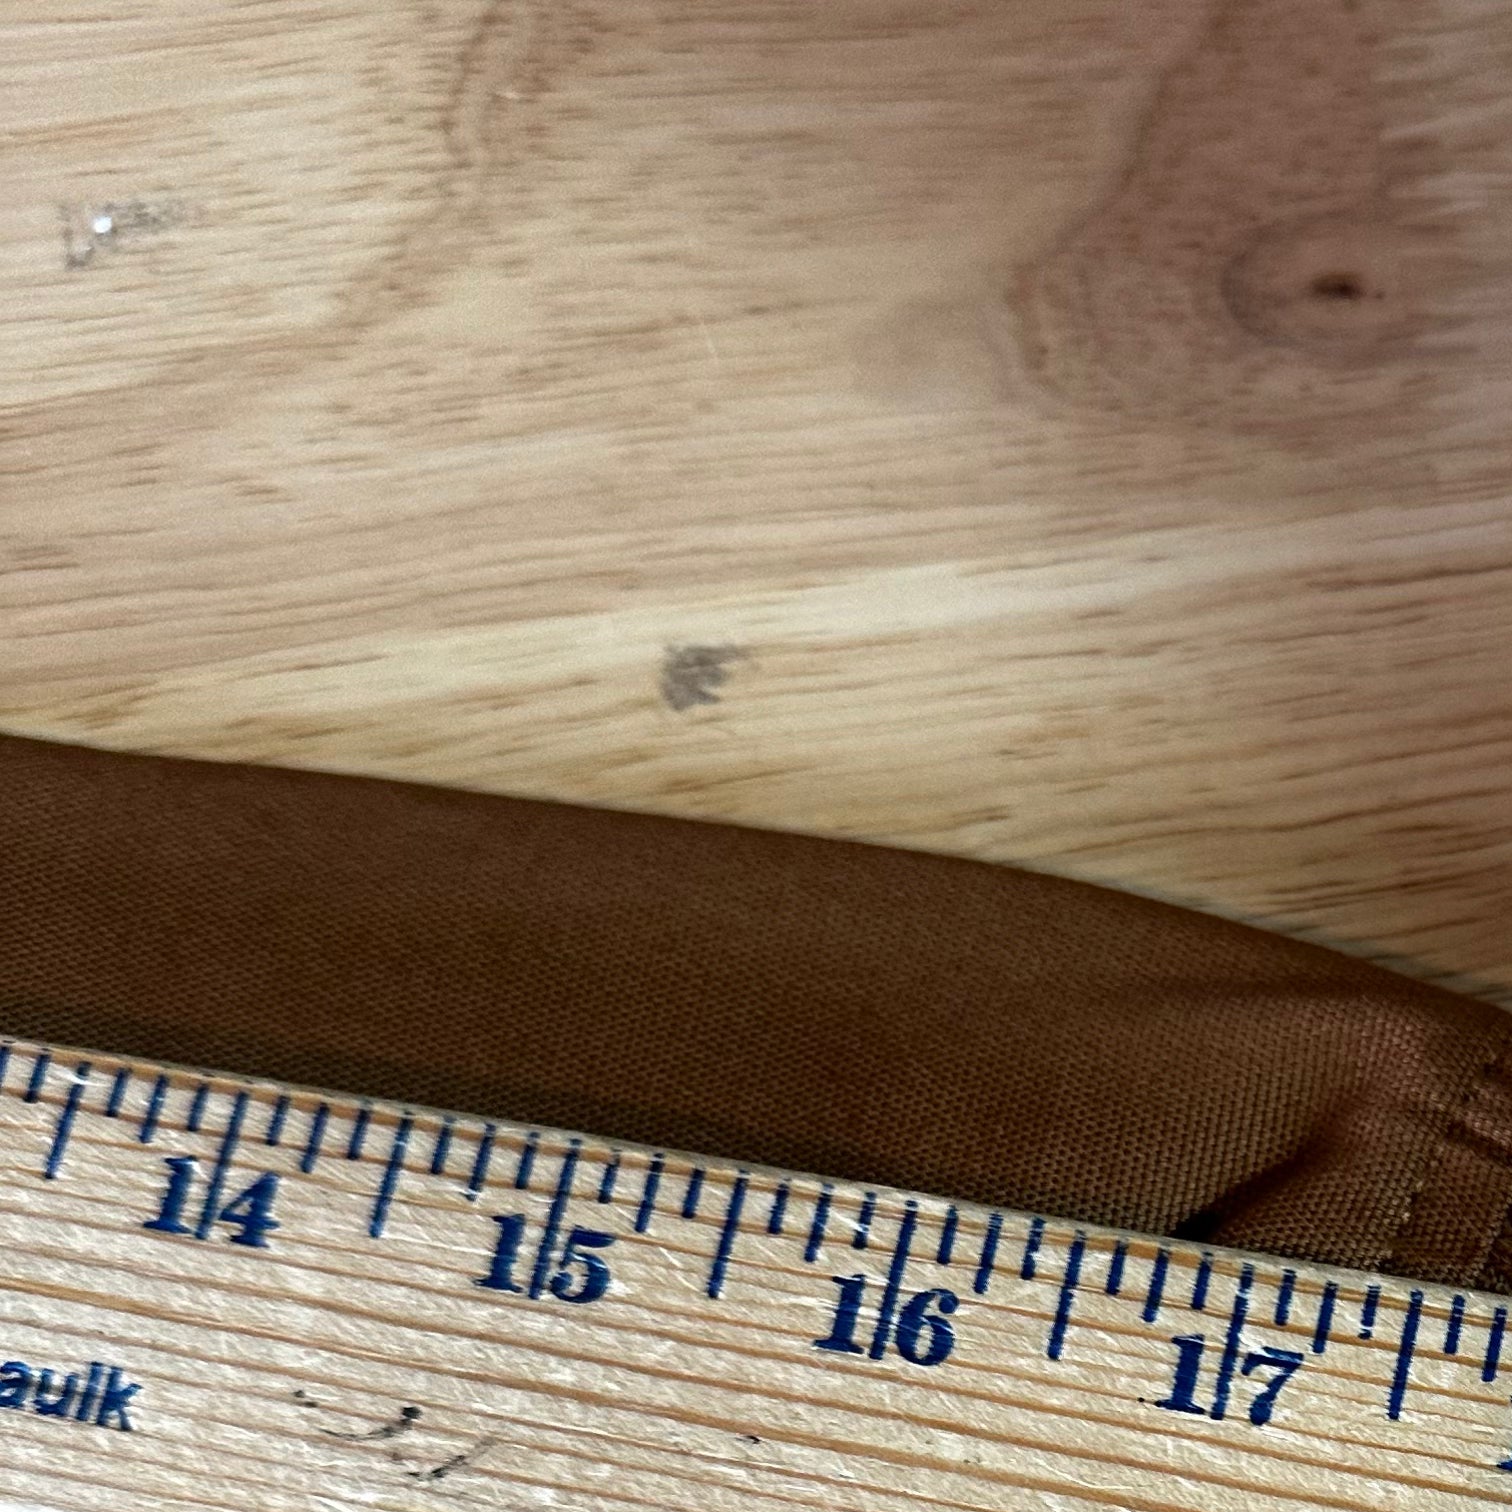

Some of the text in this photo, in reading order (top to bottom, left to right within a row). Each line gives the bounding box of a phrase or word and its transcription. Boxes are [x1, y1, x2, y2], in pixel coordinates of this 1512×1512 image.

[144, 1156, 281, 1248] 14
[475, 1214, 617, 1303] 15
[815, 1274, 960, 1366] 16
[1155, 1334, 1305, 1426] 17
